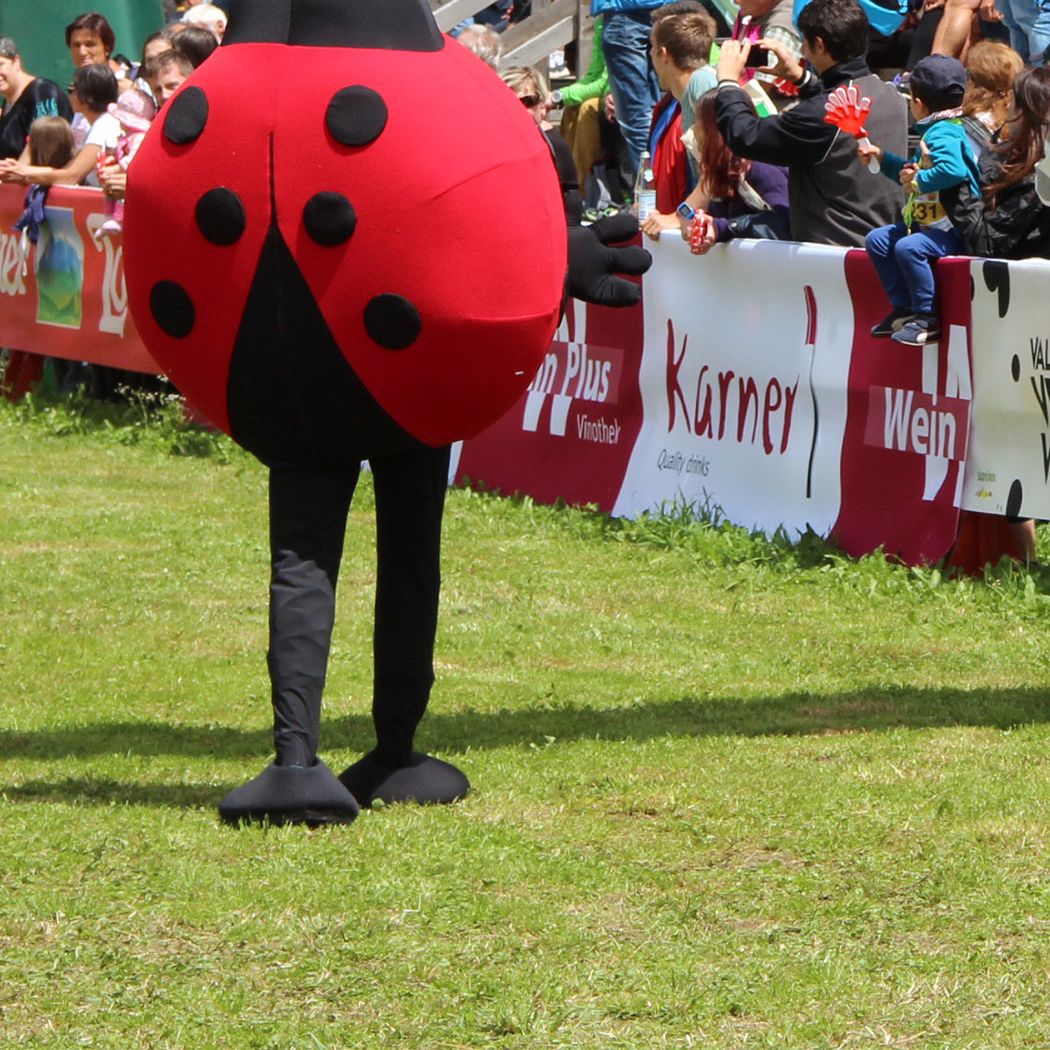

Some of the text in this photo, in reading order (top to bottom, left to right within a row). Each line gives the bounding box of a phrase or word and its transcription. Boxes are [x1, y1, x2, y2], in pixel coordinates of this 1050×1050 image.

[560, 342, 612, 403] Plus
[667, 318, 800, 456] Karner
[576, 413, 622, 445] Vinothek
[884, 387, 957, 460] Wein
